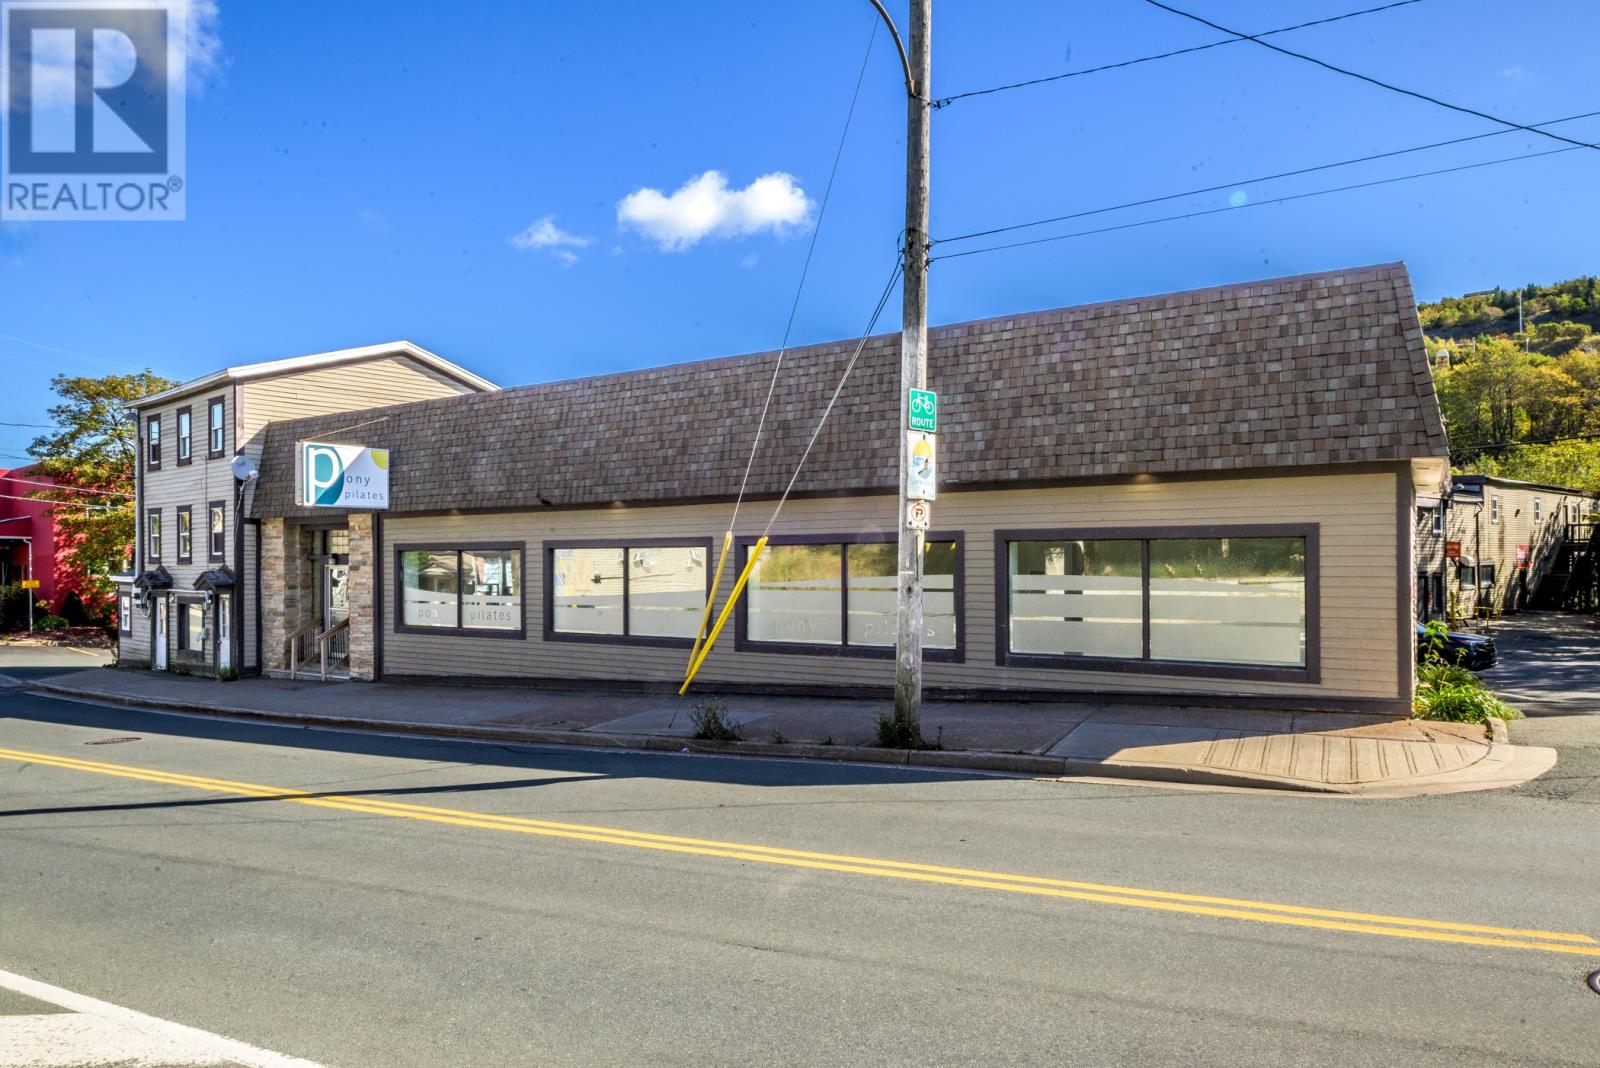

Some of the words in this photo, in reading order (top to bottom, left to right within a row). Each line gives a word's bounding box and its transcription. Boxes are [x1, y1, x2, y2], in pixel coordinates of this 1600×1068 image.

[911, 416, 934, 428] ROUTE
[344, 490, 385, 501] pilates
[470, 609, 512, 621] pilates
